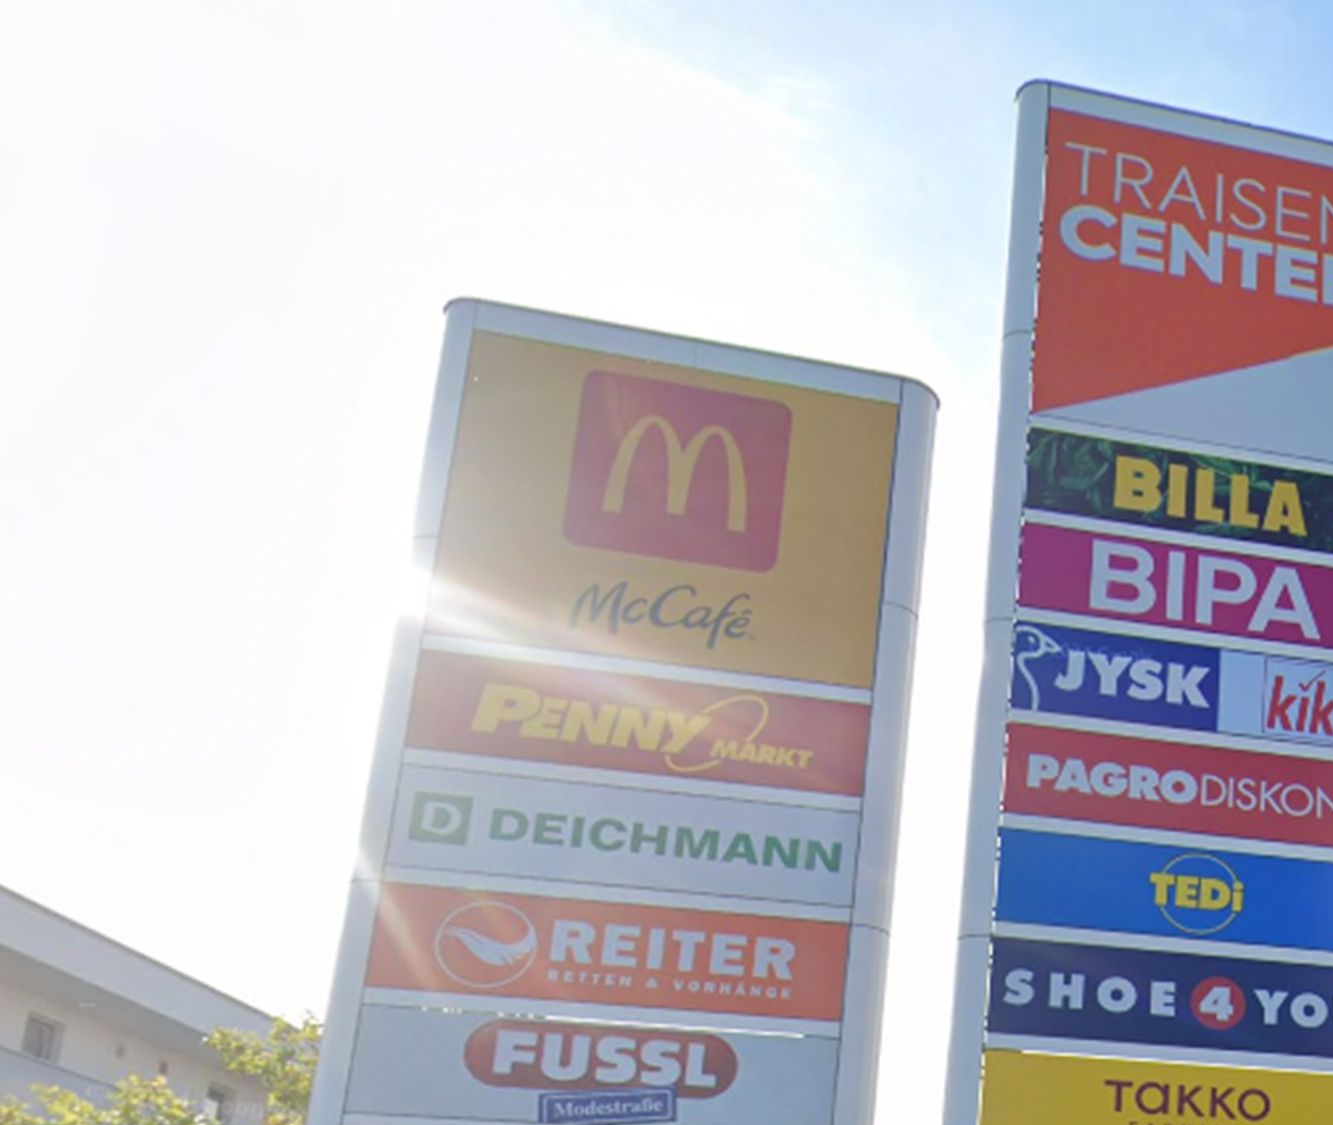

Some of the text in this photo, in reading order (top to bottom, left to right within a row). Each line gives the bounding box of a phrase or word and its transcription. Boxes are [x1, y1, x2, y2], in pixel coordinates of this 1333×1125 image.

[1113, 454, 1308, 537] BILLA
[569, 580, 754, 649] McCafé
[1088, 538, 1321, 641] BIPA
[1054, 650, 1210, 709] JYSK
[470, 682, 711, 756] PENNY
[709, 738, 814, 769] MARKT
[489, 807, 843, 872] DEICHMANN
[1149, 872, 1245, 913] TEDi
[547, 969, 632, 987] BETTEN
[550, 919, 797, 981] REITER
[1002, 968, 1176, 1018] SHOE
[1199, 986, 1234, 1021] 4
[493, 1029, 717, 1087] FUSSL
[553, 1099, 664, 1118] Modestraße
